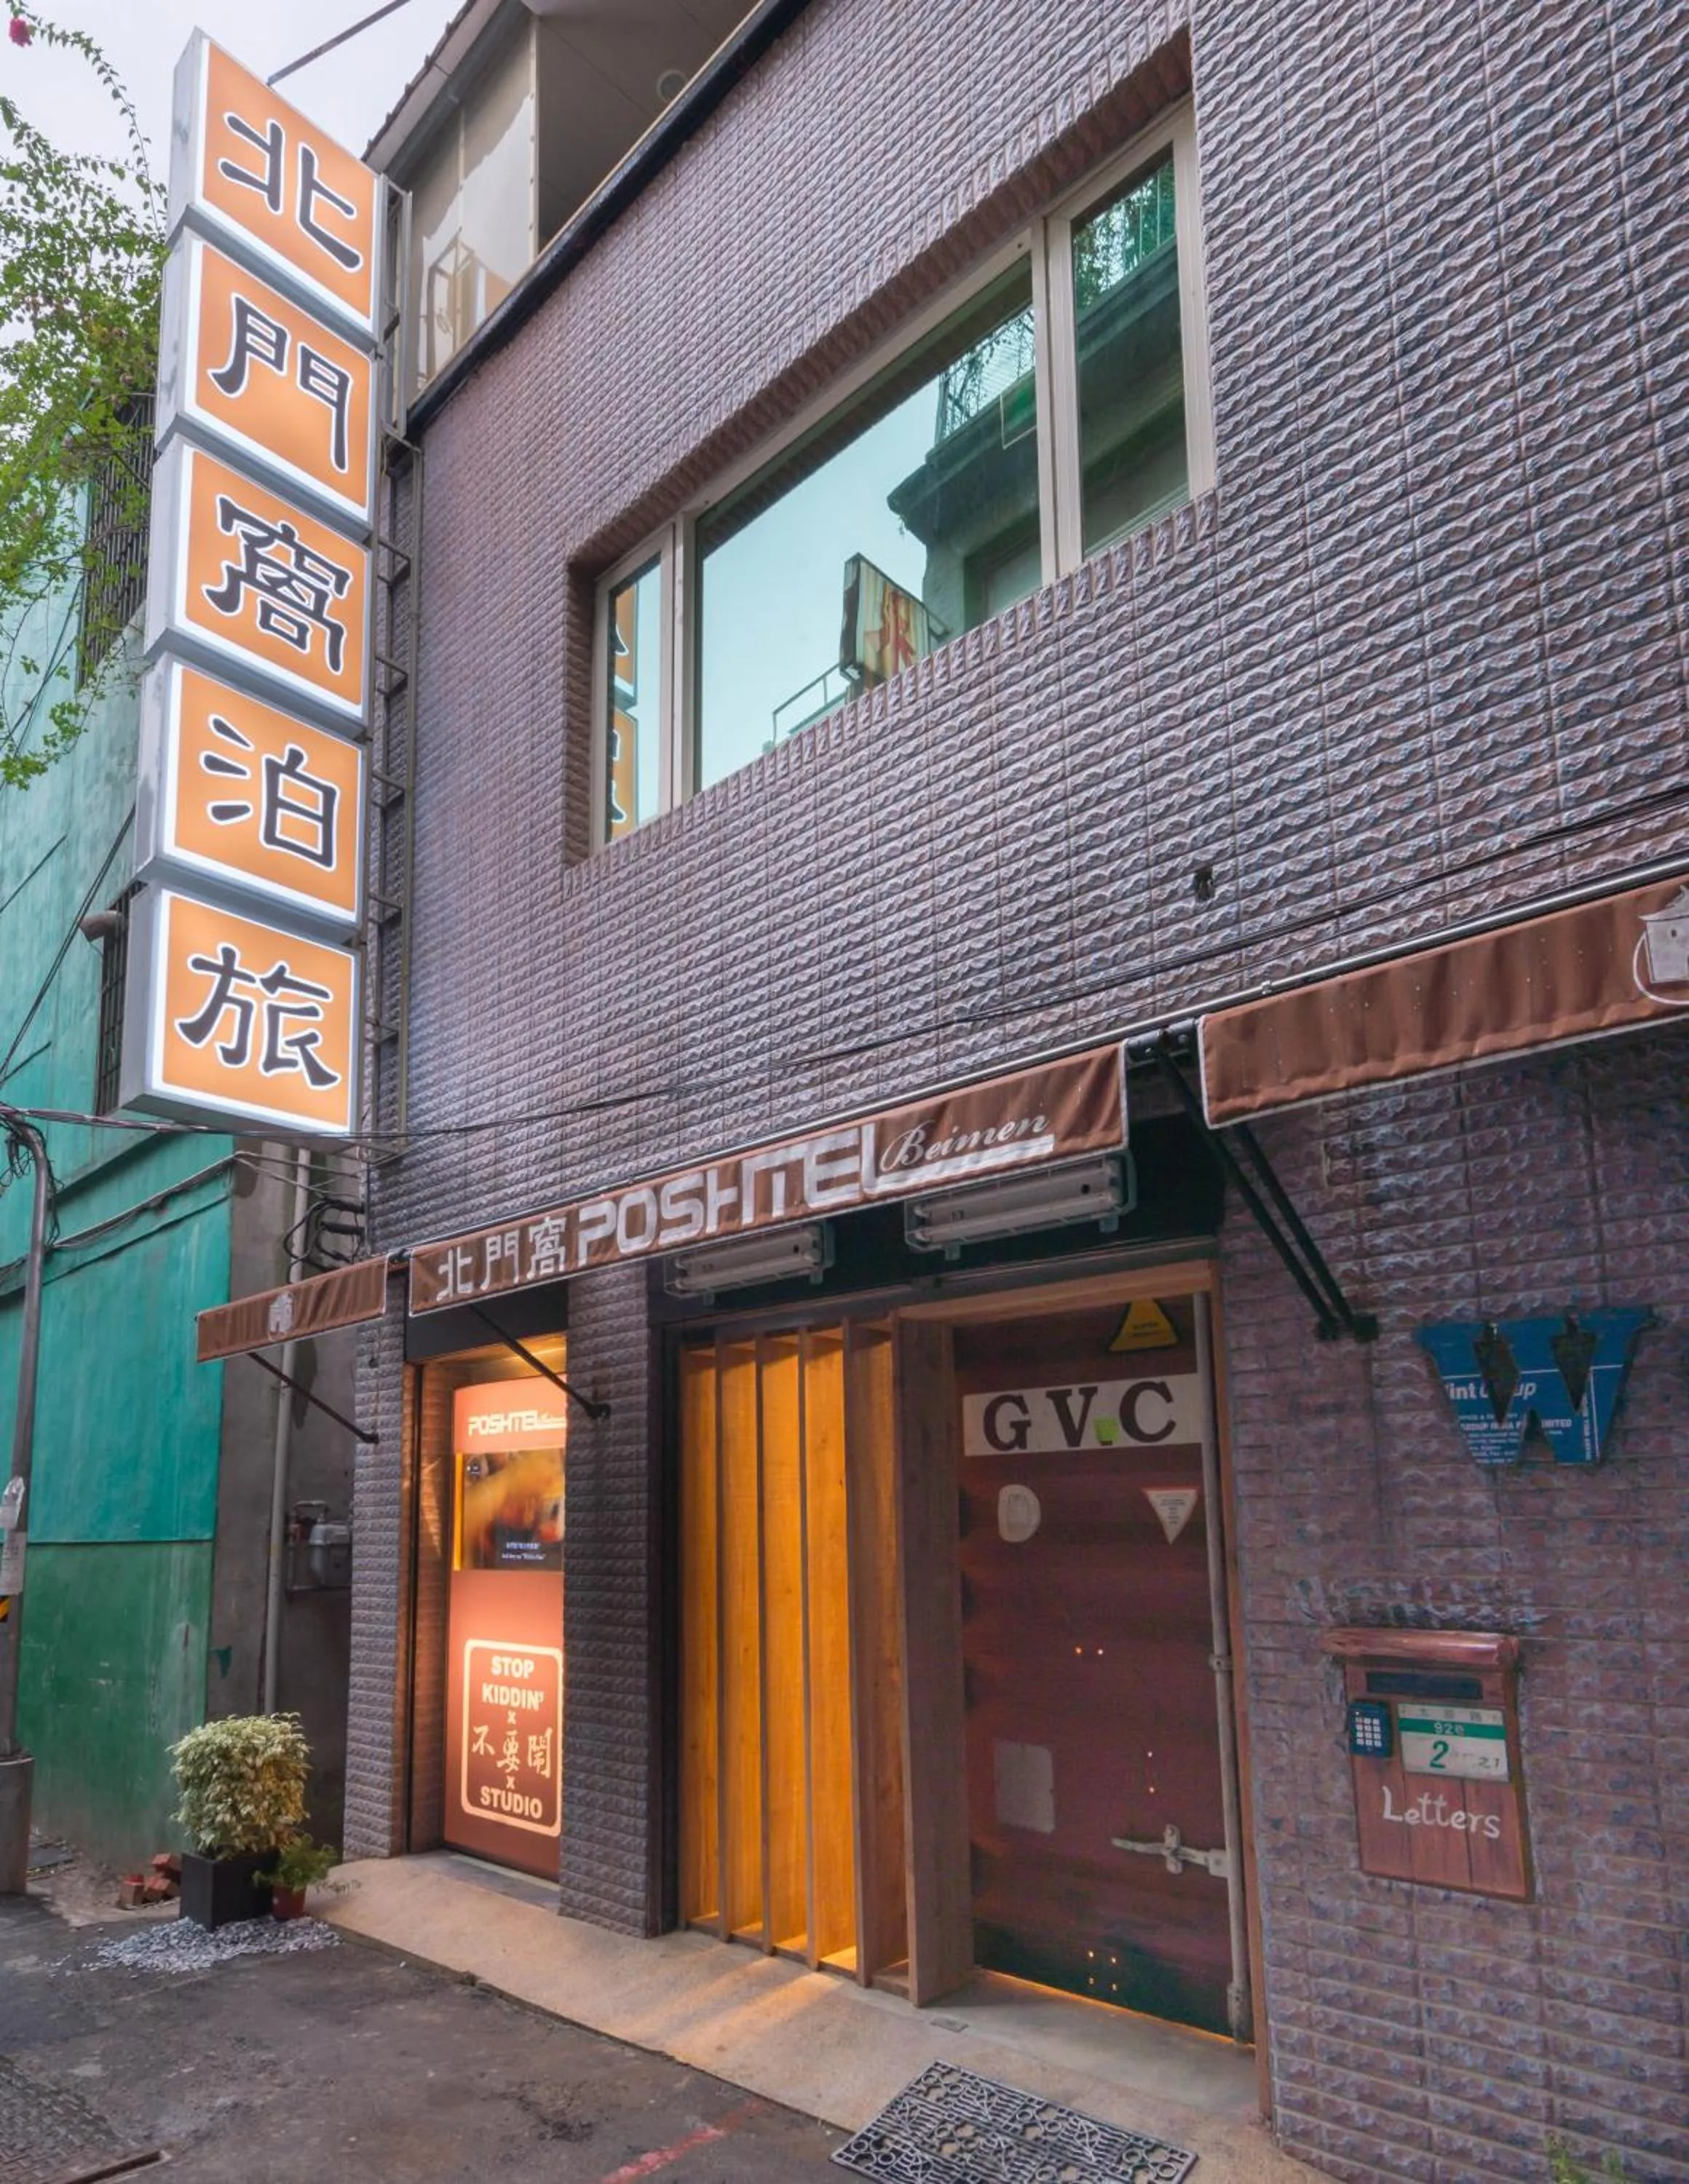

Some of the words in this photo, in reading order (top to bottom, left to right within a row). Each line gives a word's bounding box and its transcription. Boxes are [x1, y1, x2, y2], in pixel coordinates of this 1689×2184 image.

[175, 112, 362, 1088] 北門窩泊旅
[436, 1216, 566, 1302] 北門窩
[577, 1122, 879, 1267] POSHTEL
[879, 1114, 1050, 1172] Beimen
[491, 1655, 534, 1679] STOP
[482, 1683, 544, 1710] KIDDIN'
[472, 1725, 553, 1779] 不要鬧
[1429, 1740, 1449, 1769] 2
[480, 1786, 542, 1819] STUDIO
[1382, 1785, 1501, 1839] Letters
